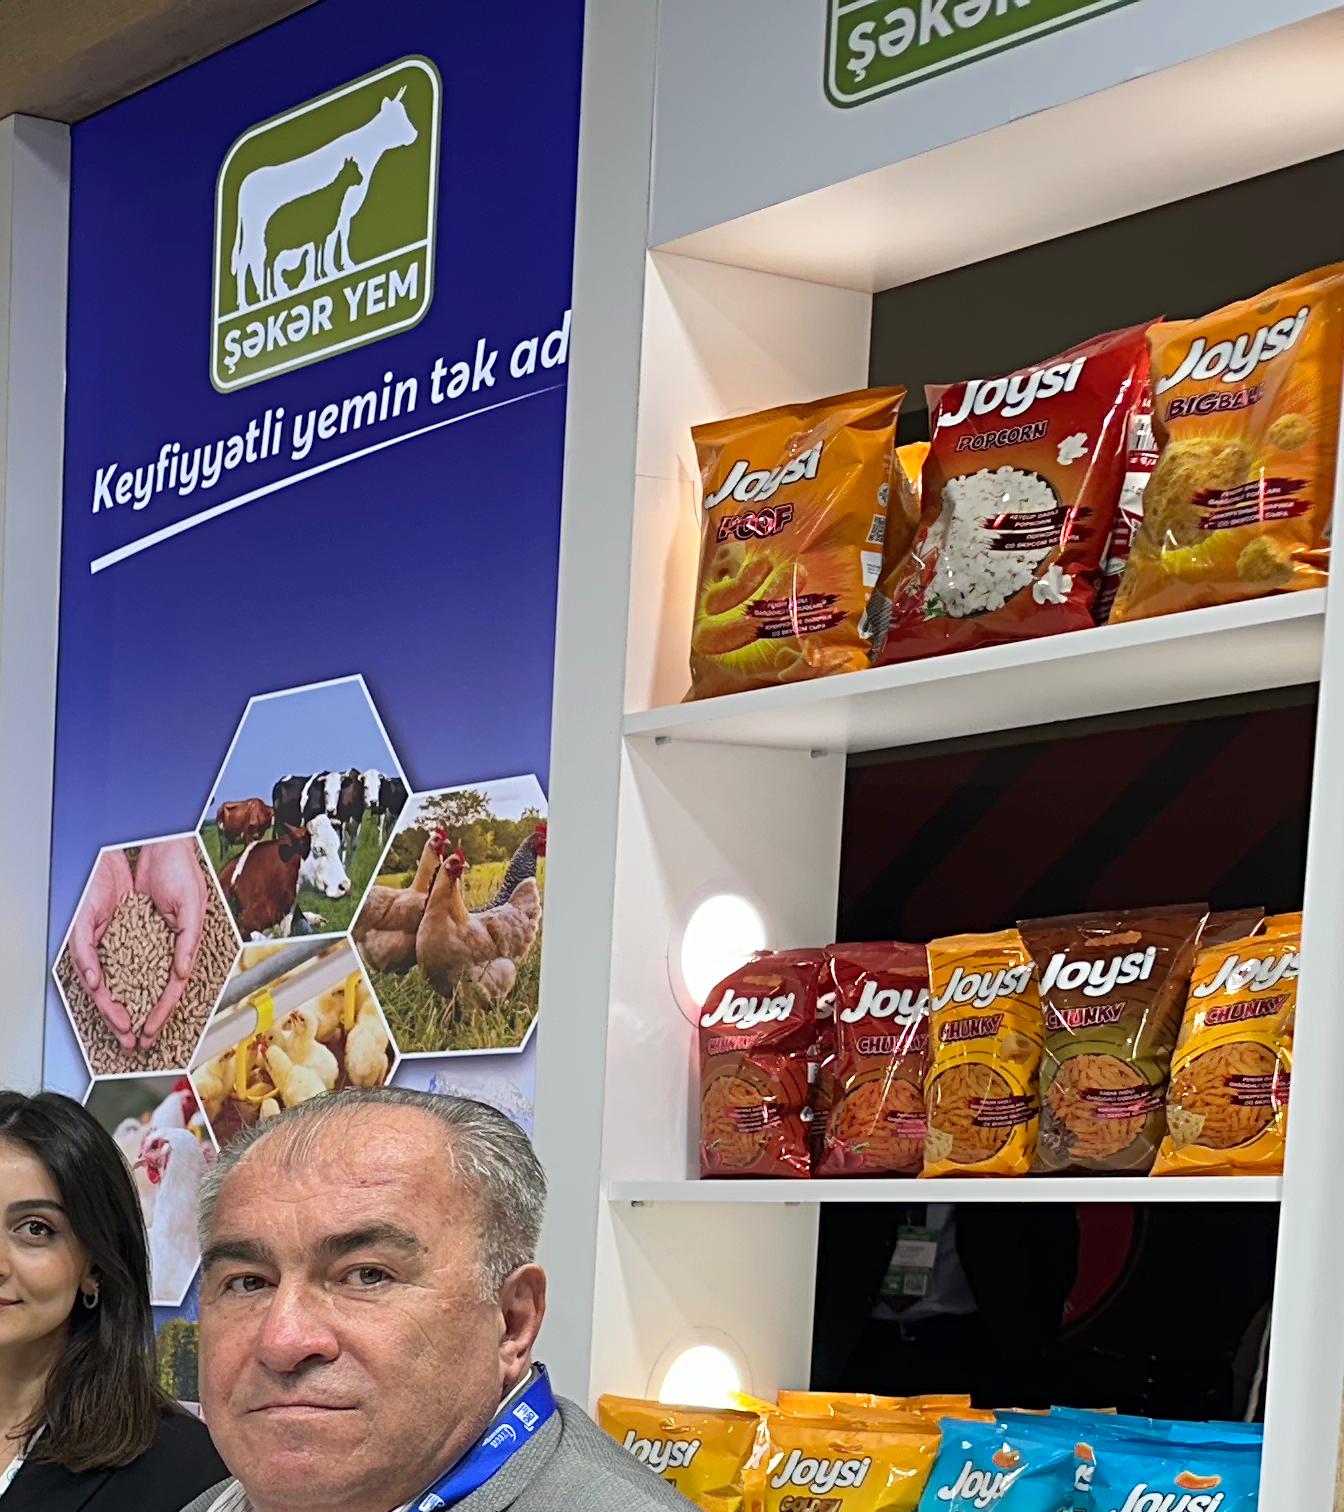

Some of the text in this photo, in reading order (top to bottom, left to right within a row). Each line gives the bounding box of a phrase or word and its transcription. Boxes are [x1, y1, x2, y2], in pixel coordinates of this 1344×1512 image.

[223, 260, 419, 375] ŞƏKƏR YEM
[1155, 305, 1311, 395] Joysi
[938, 356, 1087, 427] Joysi
[91, 408, 285, 514] Keyfiyyətli
[291, 372, 419, 462] yemin
[430, 352, 496, 404] tək
[956, 420, 1048, 451] POPCORN
[704, 440, 824, 510] Joysi
[932, 961, 1036, 1011] Joysi
[1039, 946, 1156, 997] Joysi
[700, 989, 795, 1029] Joysi
[939, 1013, 1004, 1043] CHUNKY
[1045, 1001, 1127, 1031] CHUNKY
[1203, 993, 1291, 1026] CHUNKY
[769, 1449, 872, 1495] Joysi
